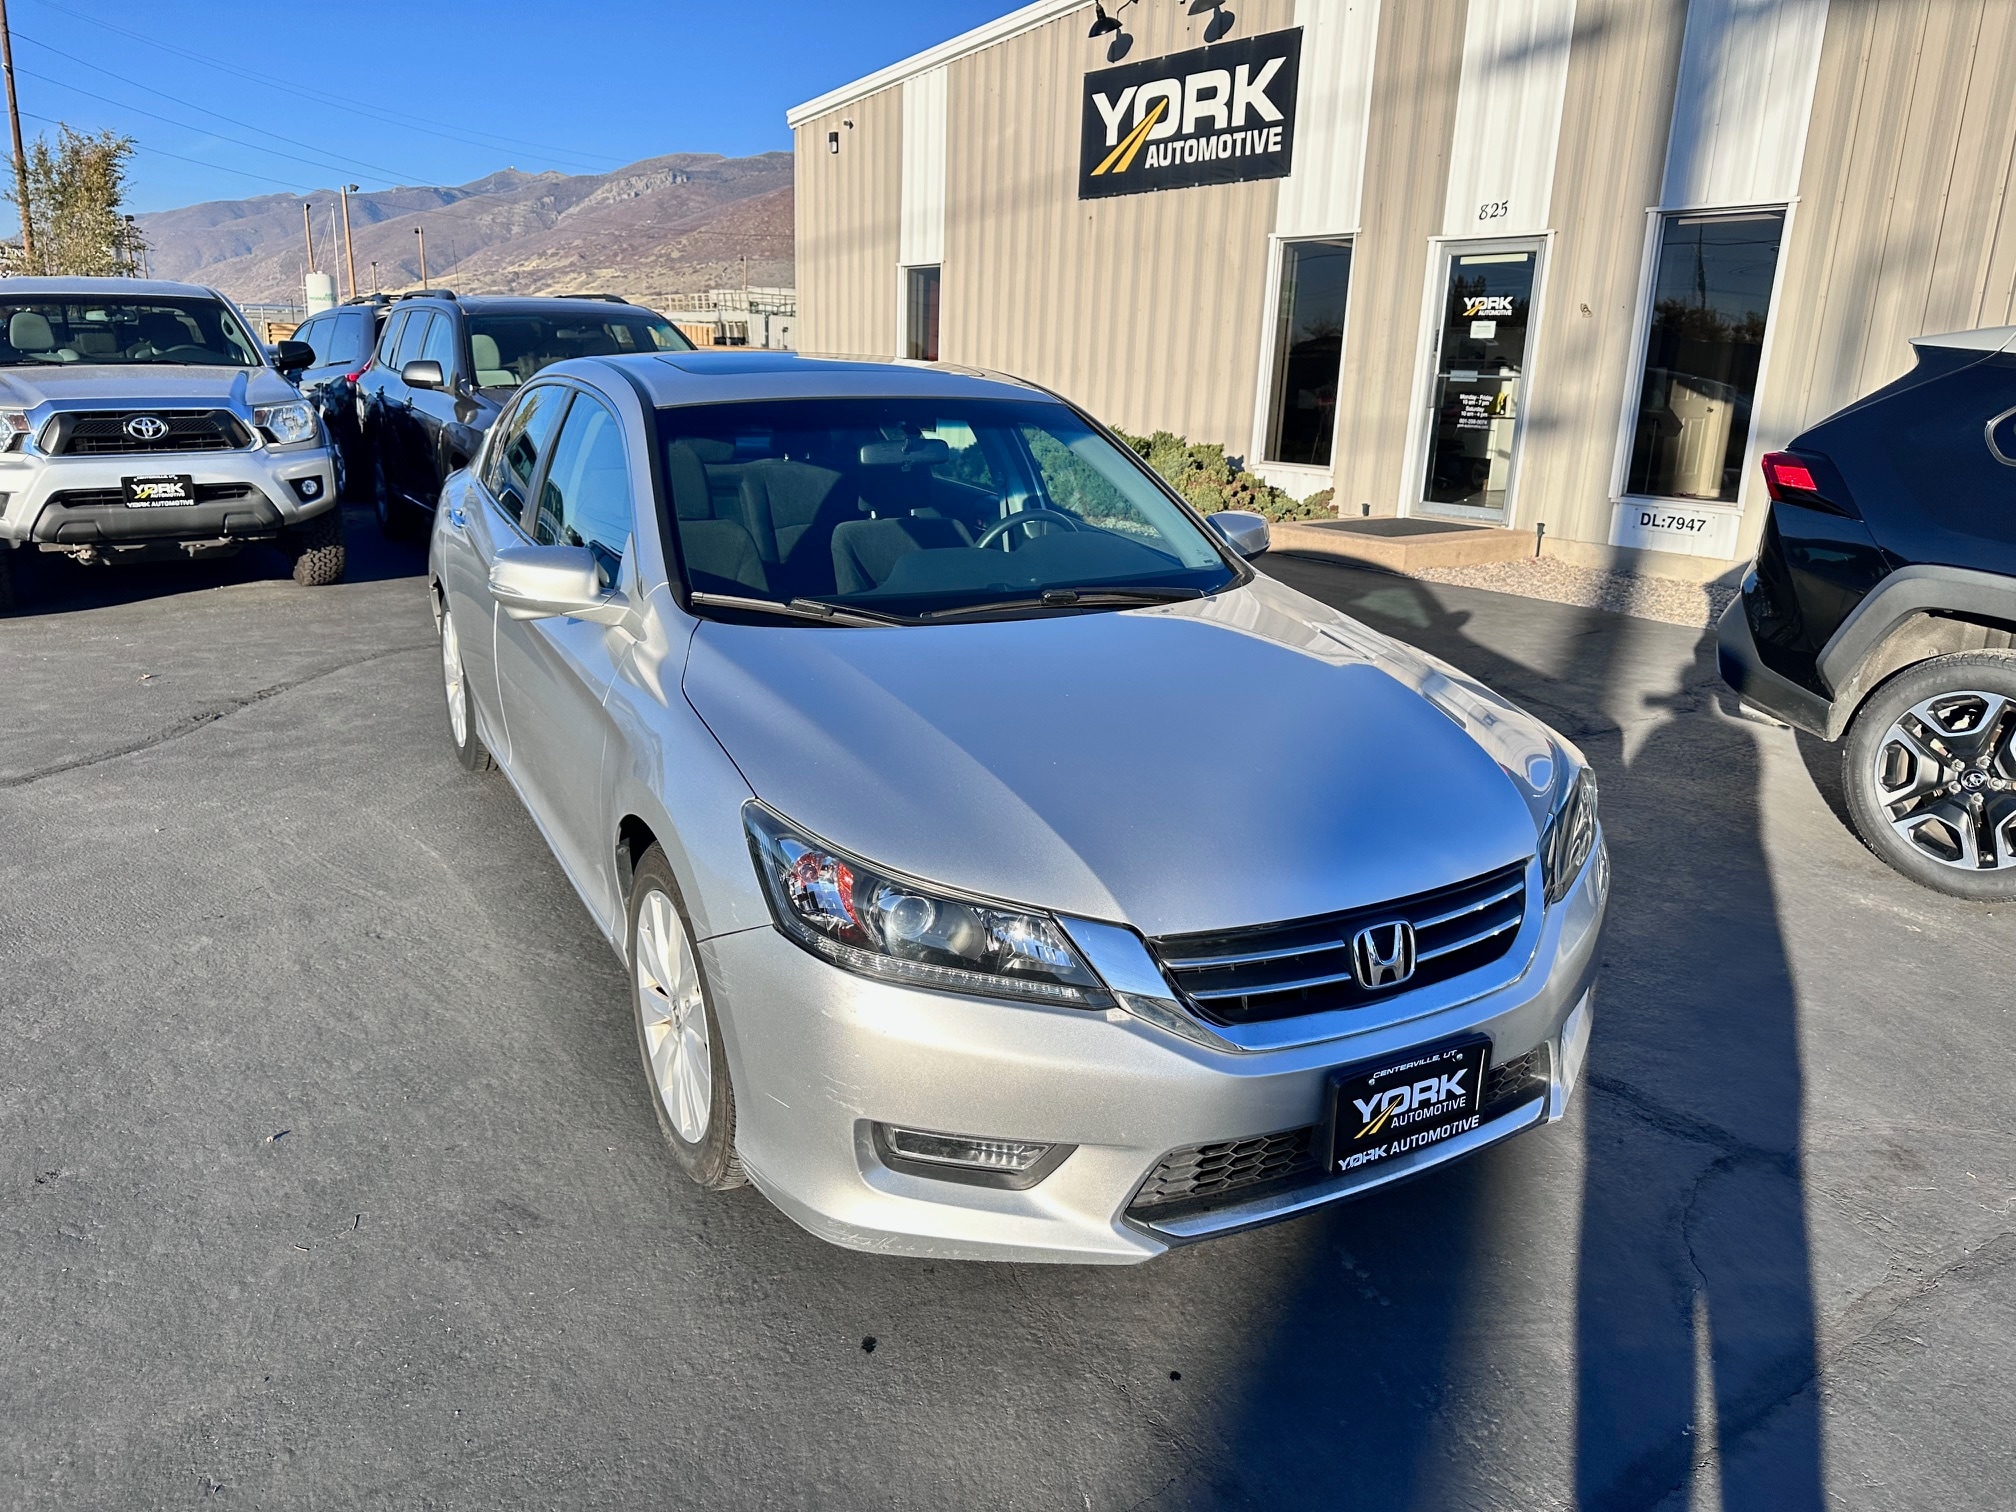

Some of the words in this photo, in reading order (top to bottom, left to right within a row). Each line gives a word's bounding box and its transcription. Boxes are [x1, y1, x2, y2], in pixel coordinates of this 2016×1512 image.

[1092, 57, 1287, 147] YORK
[1144, 126, 1283, 169] AUTOMOTIVE
[1479, 200, 1508, 220] 825
[1463, 296, 1514, 310] YORK
[131, 482, 185, 495] YORK
[151, 499, 195, 507] AUTOMOTIVE
[1640, 512, 1706, 532] DL:7947
[1373, 1055, 1441, 1079] CENTERVILLE,
[1443, 1049, 1458, 1059] UT
[1352, 1068, 1468, 1124] YORK
[1390, 1096, 1467, 1129] AUTOMOTIVE
[1338, 1144, 1388, 1171] YORK
[1389, 1114, 1480, 1155] AUTOMOTIVE
